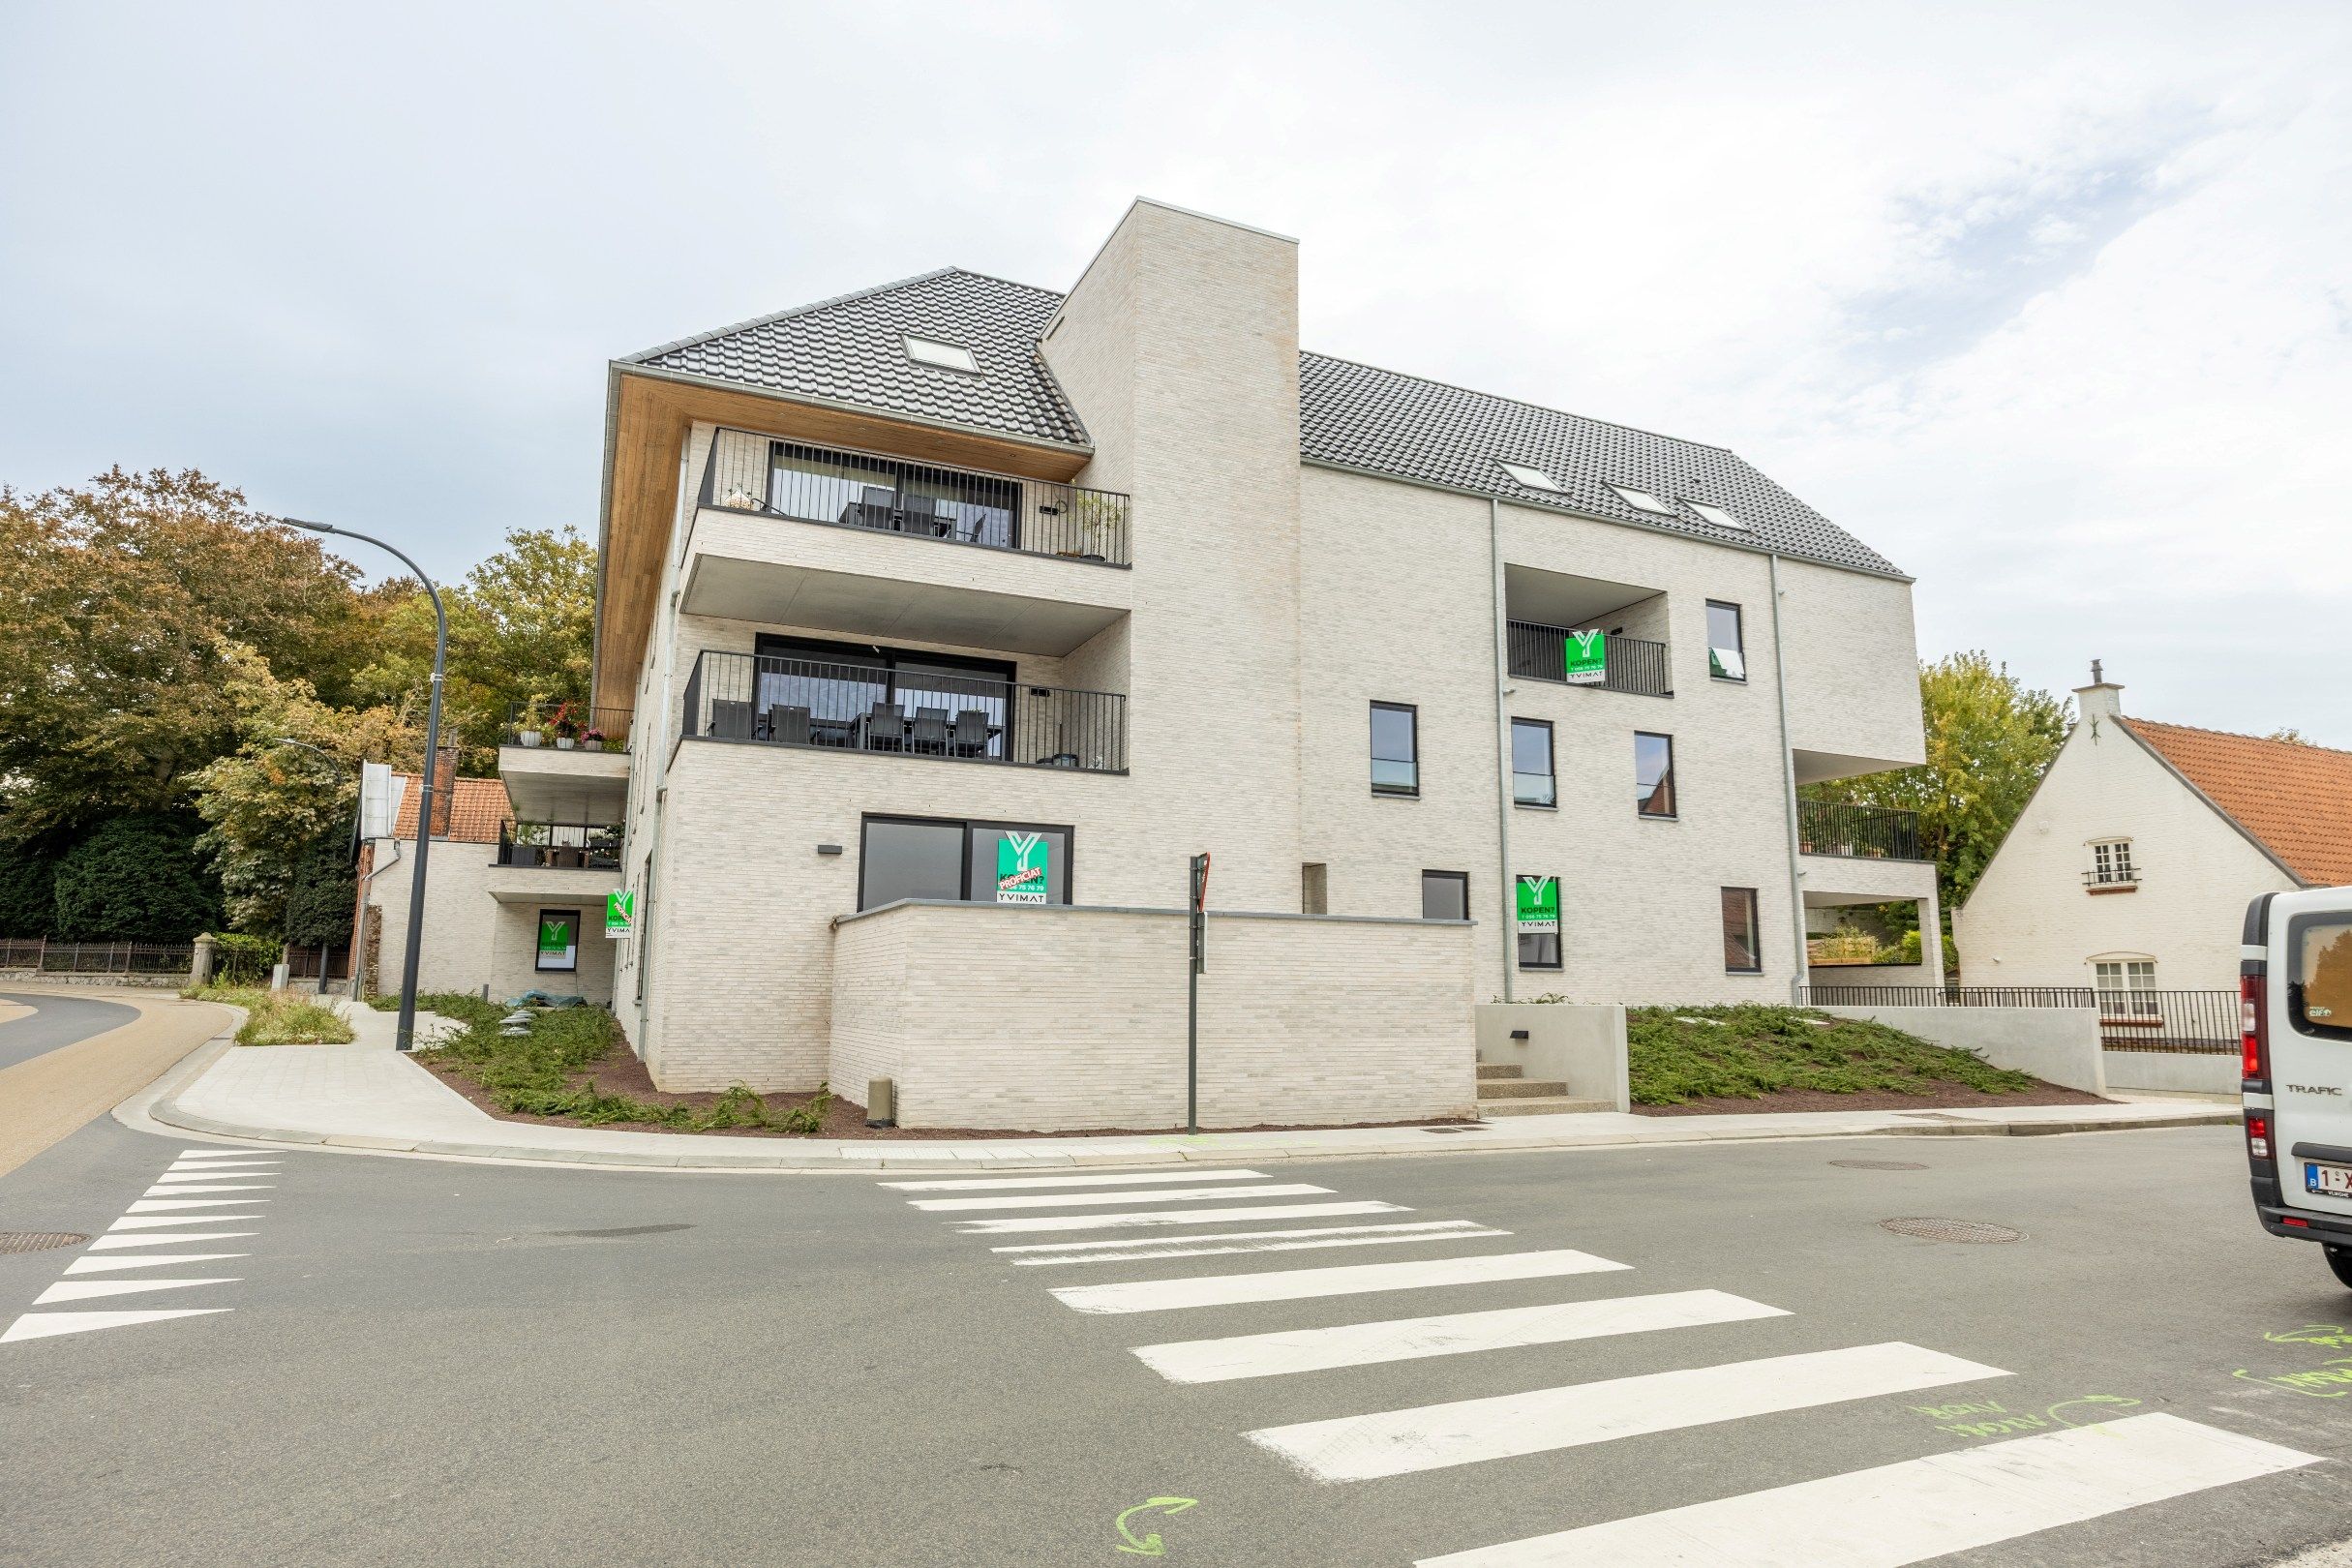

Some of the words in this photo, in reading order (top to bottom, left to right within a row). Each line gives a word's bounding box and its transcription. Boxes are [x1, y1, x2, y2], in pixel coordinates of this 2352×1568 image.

[1570, 658, 1603, 667] KOPEN?
[998, 866, 1042, 890] PROFICIAT
[999, 893, 1044, 902] YVIMAT
[2285, 1084, 2342, 1096] TRAFIC
[2309, 1178, 2317, 1187] B
